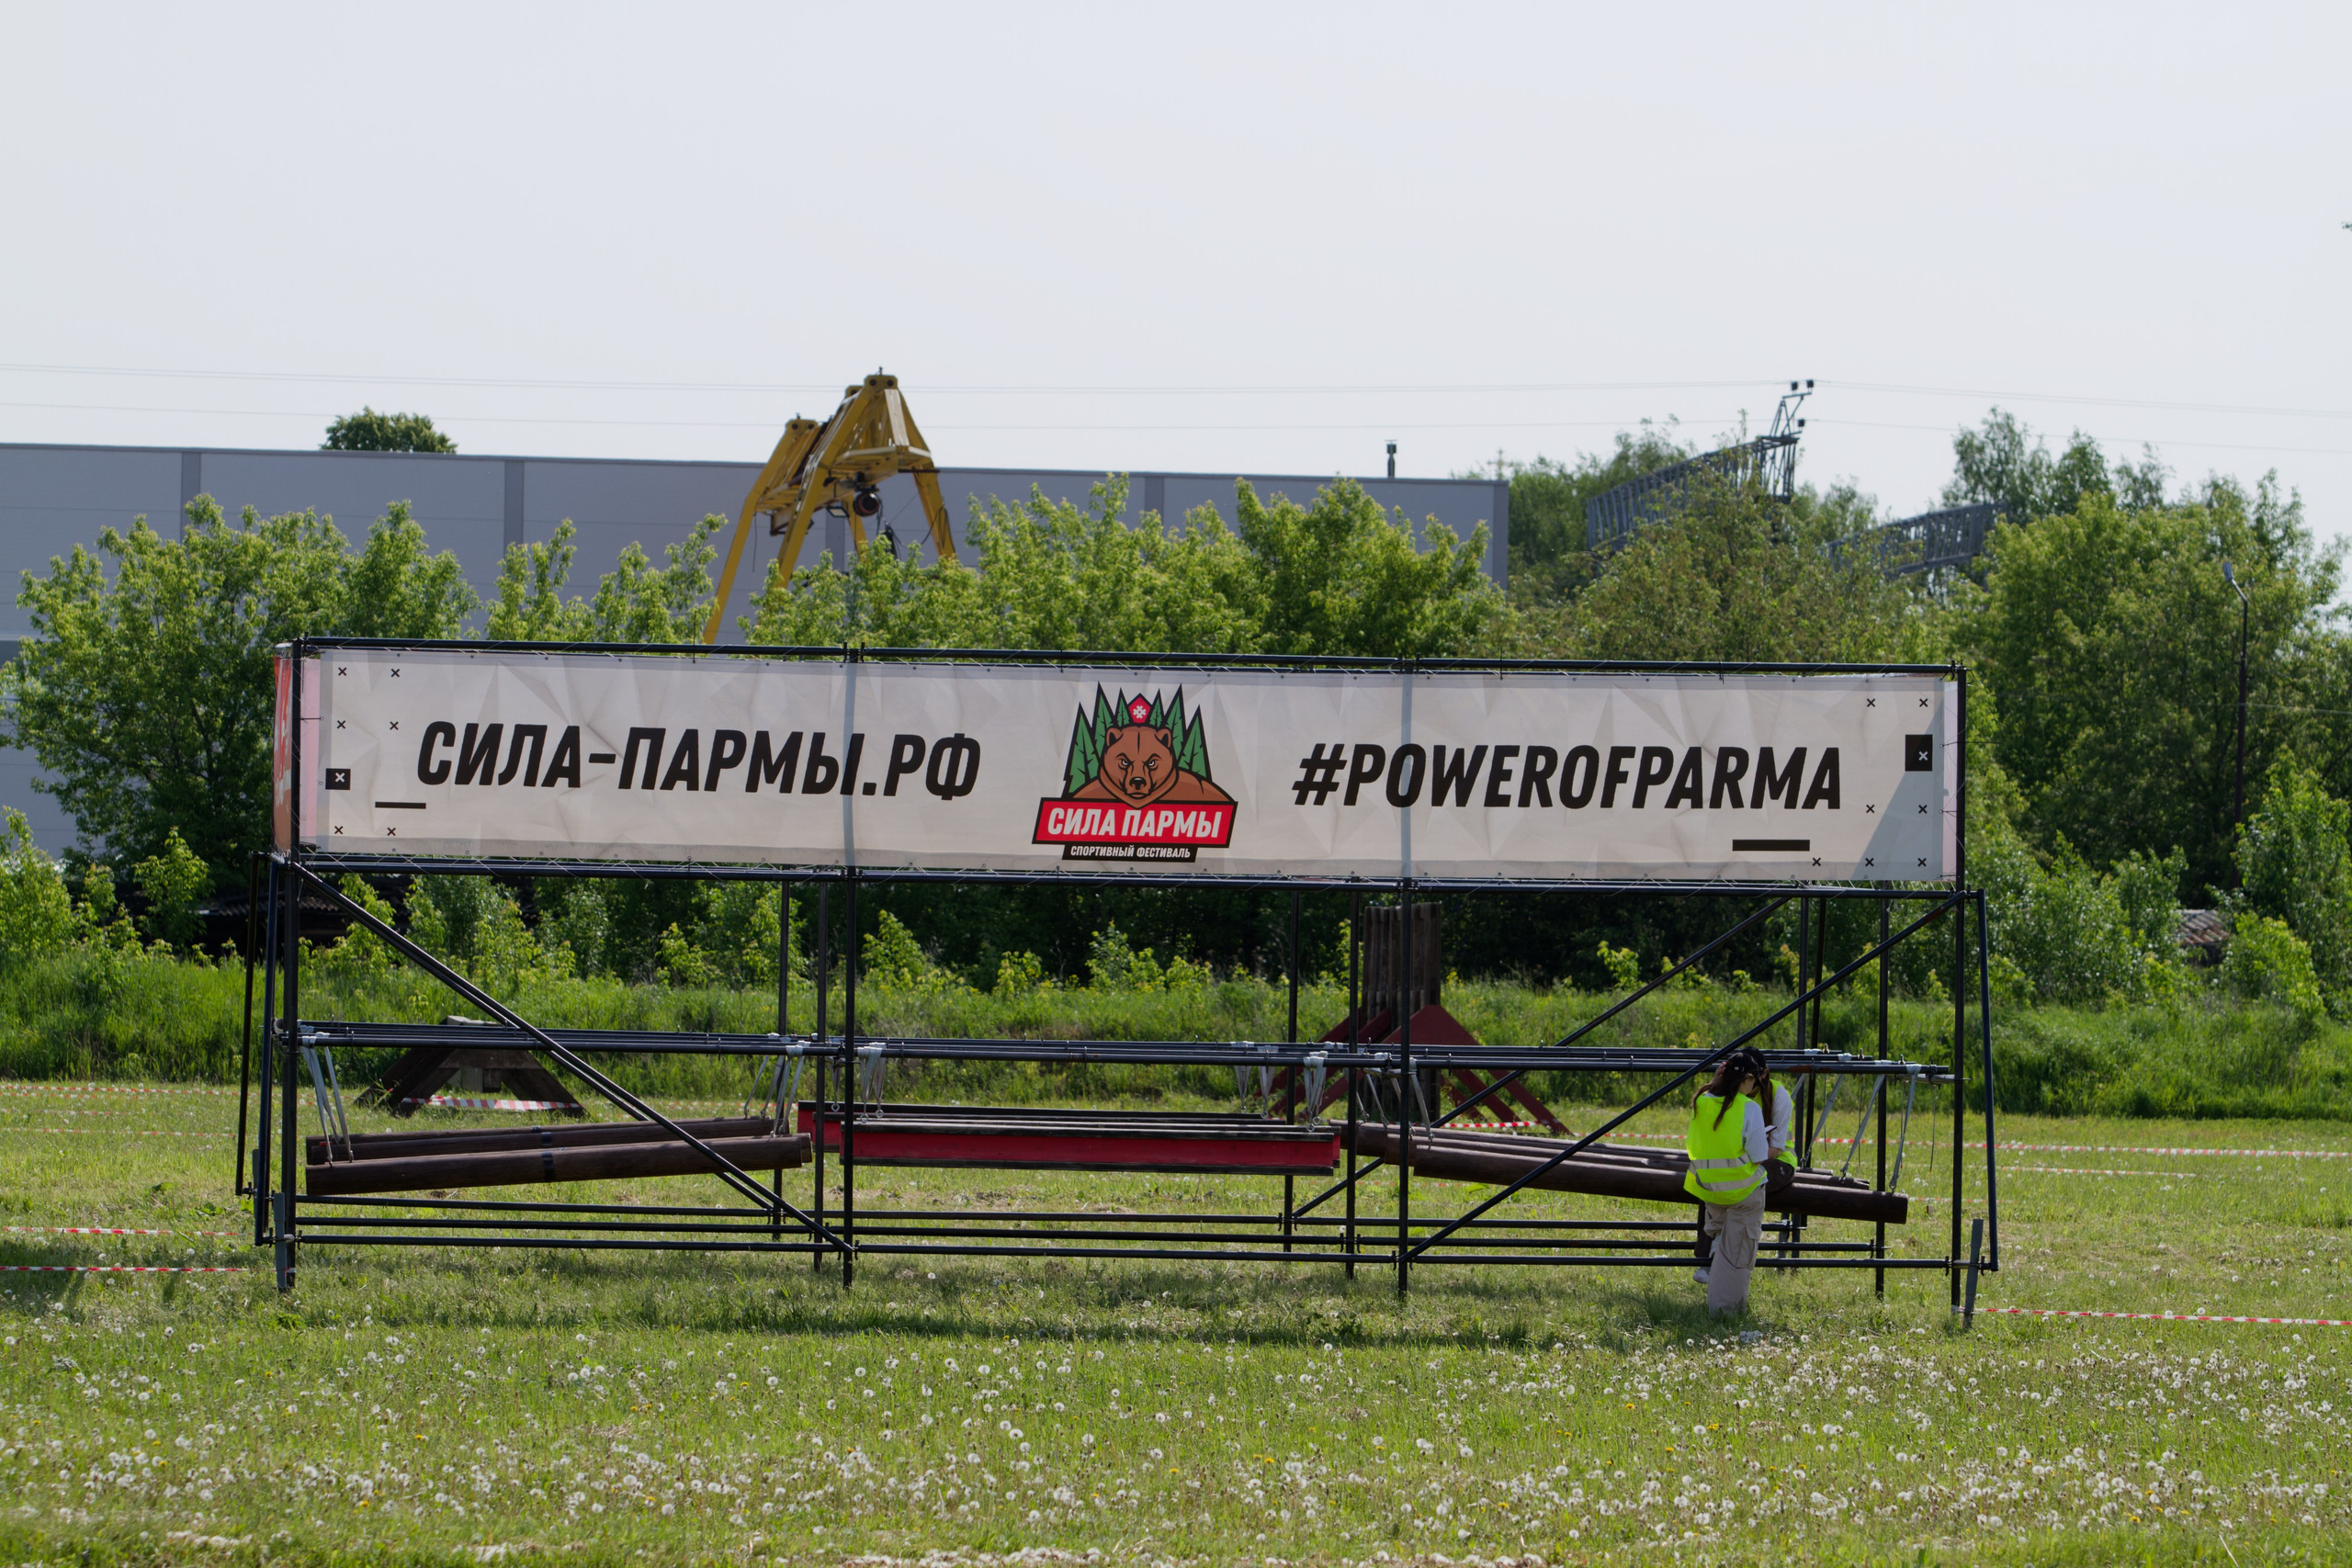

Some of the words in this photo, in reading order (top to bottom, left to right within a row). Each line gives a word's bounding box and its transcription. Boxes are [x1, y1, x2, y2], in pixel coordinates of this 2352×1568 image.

[417, 720, 981, 801] СИЛА-ПАРМЫ.РФ
[1291, 742, 1841, 810] #POWEROFPARMA
[1047, 807, 1115, 836] СИЛА
[1121, 809, 1223, 839] ПАРМЫ
[1070, 844, 1135, 857] СПОРТИВНЫЙ
[1136, 846, 1191, 859] ФЕСТИВАЛЬ
